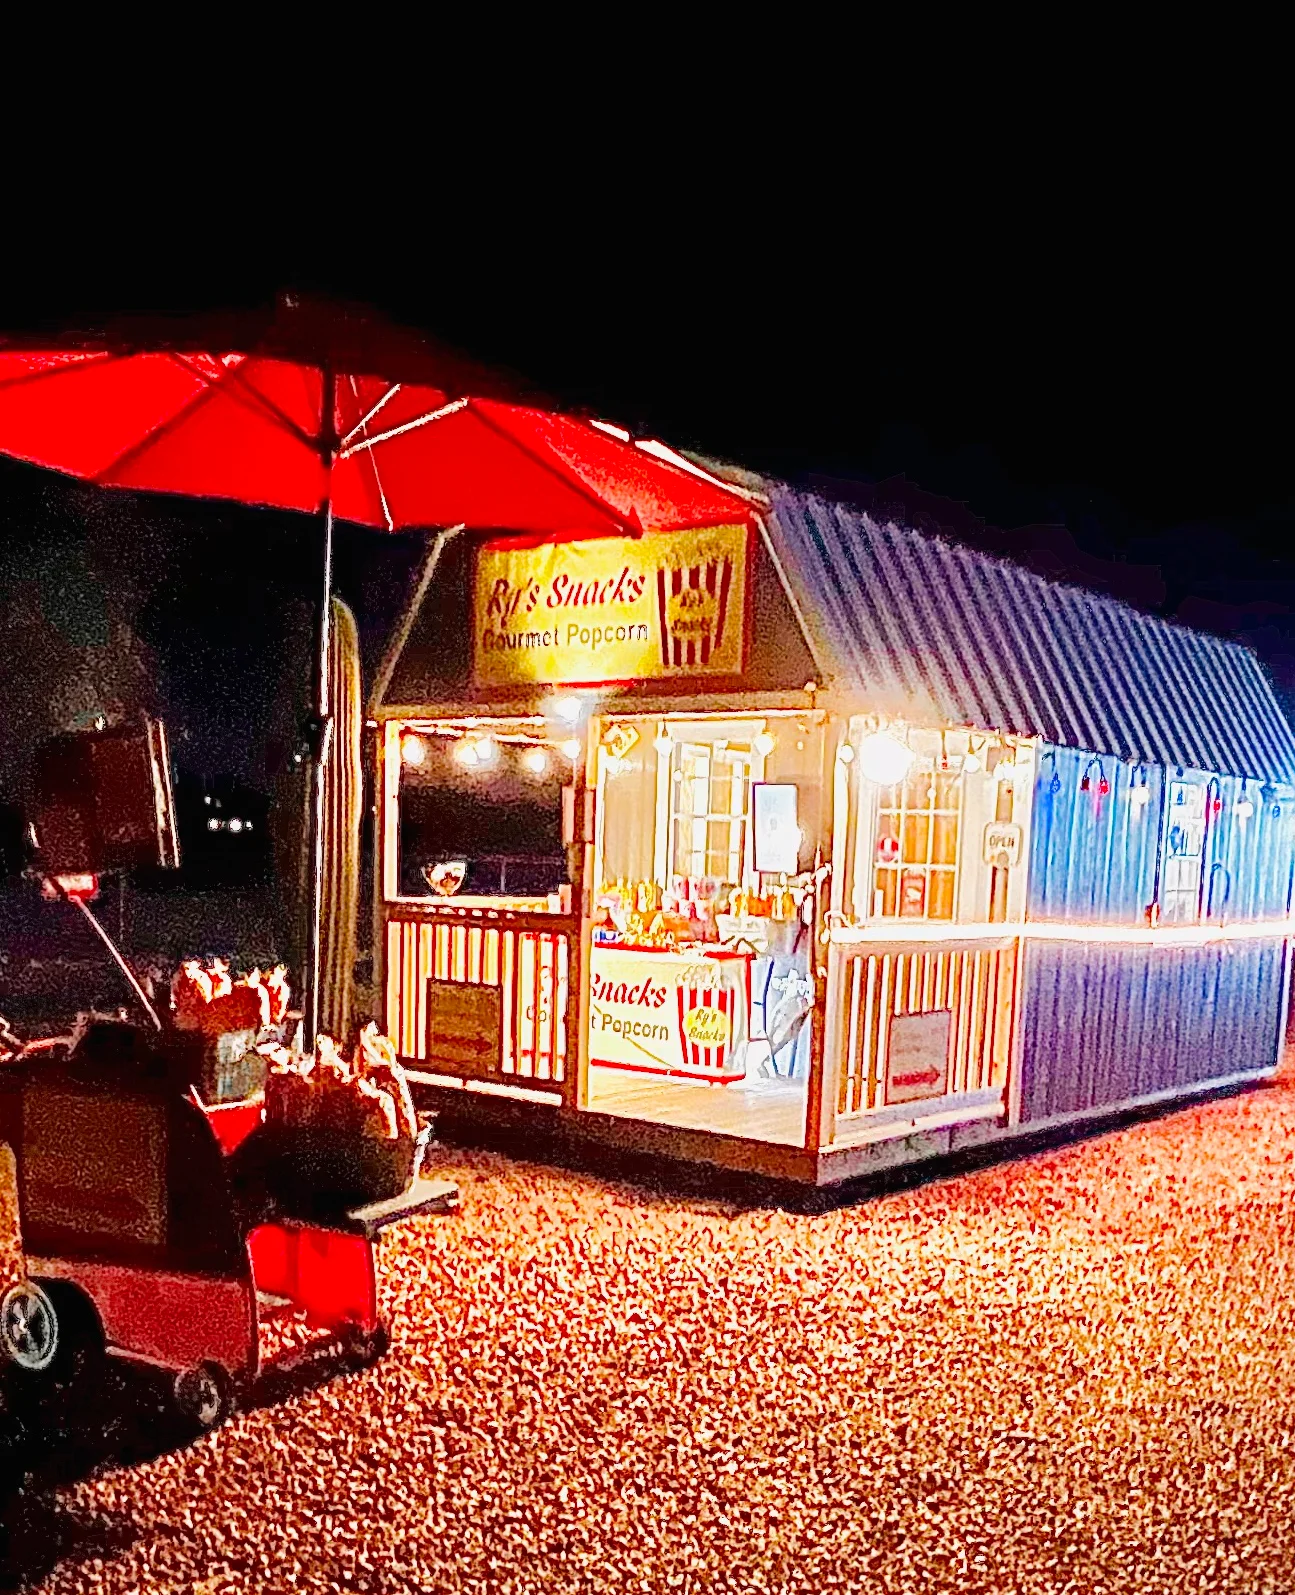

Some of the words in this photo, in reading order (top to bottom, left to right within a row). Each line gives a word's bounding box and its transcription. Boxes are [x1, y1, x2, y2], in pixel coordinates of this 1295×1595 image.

[487, 576, 540, 629] Ry's
[546, 566, 646, 609] Snacks
[483, 623, 559, 650] Gourmet
[567, 622, 648, 650] Popcorn
[989, 834, 1015, 848] OPEN
[601, 1013, 669, 1041] Popcorn
